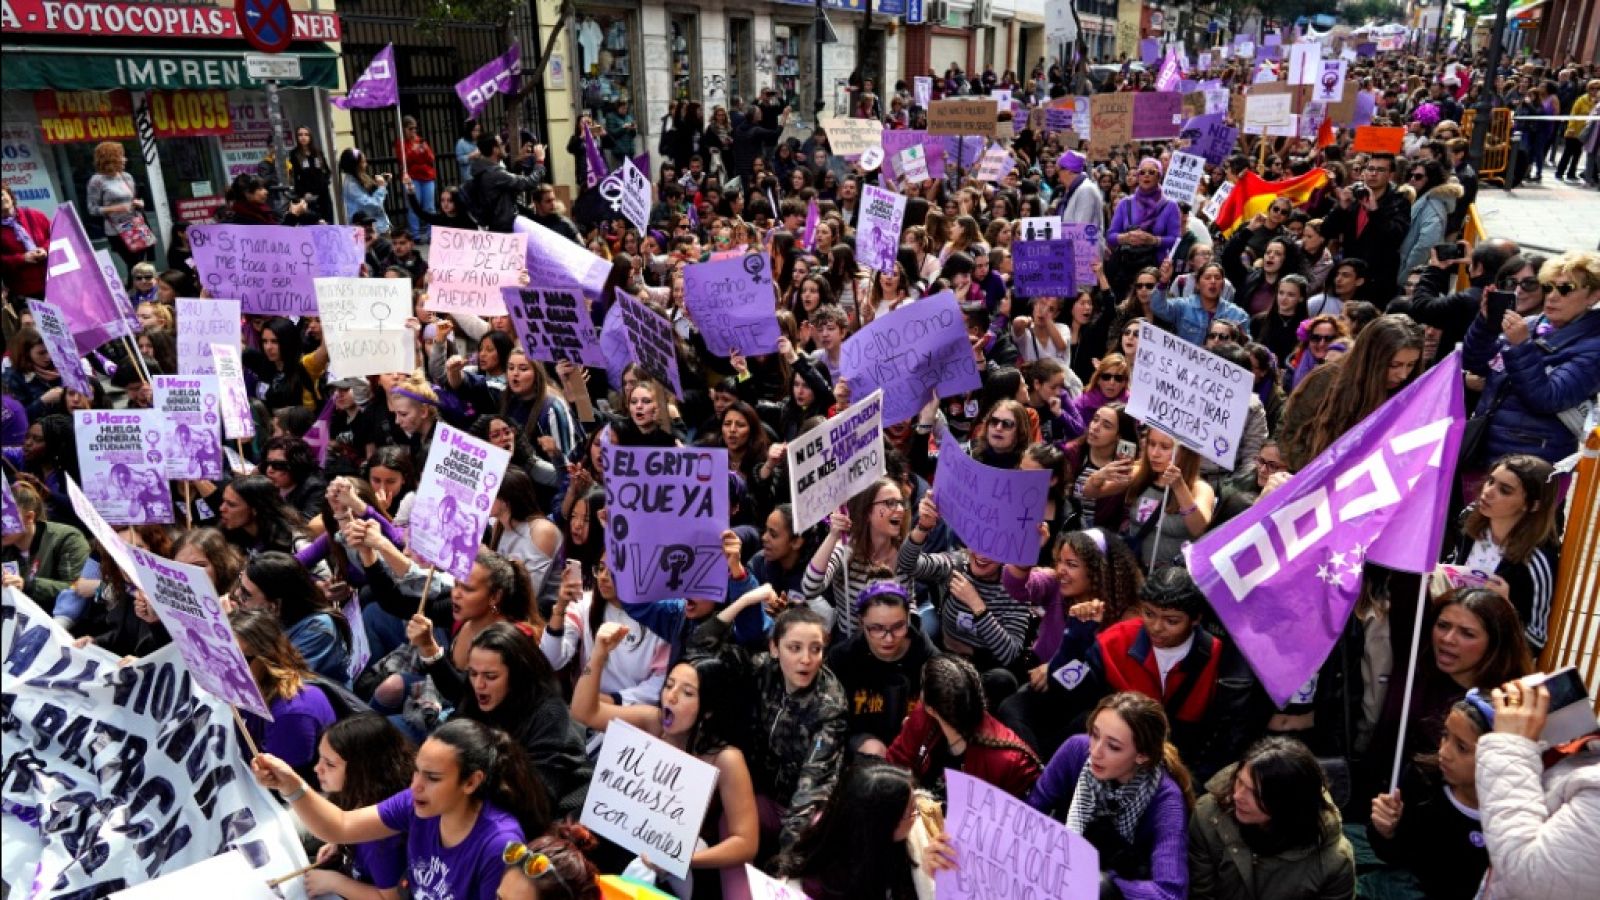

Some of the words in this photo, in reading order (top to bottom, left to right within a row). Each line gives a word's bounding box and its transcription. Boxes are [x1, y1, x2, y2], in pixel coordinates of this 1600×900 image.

[115, 58, 281, 86] IMPREN
[153, 90, 230, 132] 0,0035
[42, 118, 84, 140] TODO
[88, 115, 136, 138] COLOR
[1208, 123, 1231, 139] NO
[1210, 139, 1232, 154] ES
[439, 231, 495, 249] SOMOS
[500, 236, 520, 254] LA
[474, 252, 494, 270] DE
[500, 254, 525, 271] LAS
[461, 269, 479, 284] YA
[480, 272, 499, 286] NO
[437, 290, 487, 307] PUEDEN
[1143, 326, 1156, 344] EL
[1164, 335, 1242, 383] PATRIARCADO
[166, 378, 201, 388] Marzo
[1138, 347, 1155, 367] NO
[1159, 356, 1173, 375] SE
[1177, 364, 1188, 385] VA
[1190, 374, 1199, 390] A
[1201, 379, 1234, 407] CAER
[1139, 370, 1152, 385] LO
[1186, 394, 1196, 407] A
[82, 412, 92, 425] 8
[96, 412, 141, 425] Marzo
[101, 425, 142, 434] HUELGA
[95, 435, 142, 443] GENERAL
[440, 428, 449, 442] 8
[451, 433, 487, 460] Marzo
[795, 436, 823, 465] NOS
[443, 457, 481, 482] GENERAL
[450, 449, 484, 471] HUELGA
[613, 450, 640, 477] EL
[645, 451, 713, 482] GRITO
[434, 463, 478, 491] ESTUDIANTIL
[797, 469, 817, 495] QUE
[817, 457, 837, 481] NOS
[618, 482, 675, 513] QUE
[678, 484, 713, 518] YA
[992, 478, 1013, 504] LA
[617, 741, 651, 778] ni
[653, 759, 684, 792] un
[598, 767, 686, 826] machista
[592, 800, 629, 830] con
[632, 818, 685, 863] dientes
[967, 780, 996, 822] LA
[1000, 800, 1070, 866] FORMA
[957, 810, 991, 852] EN
[990, 828, 1020, 874] LA
[1025, 846, 1072, 900] QUE
